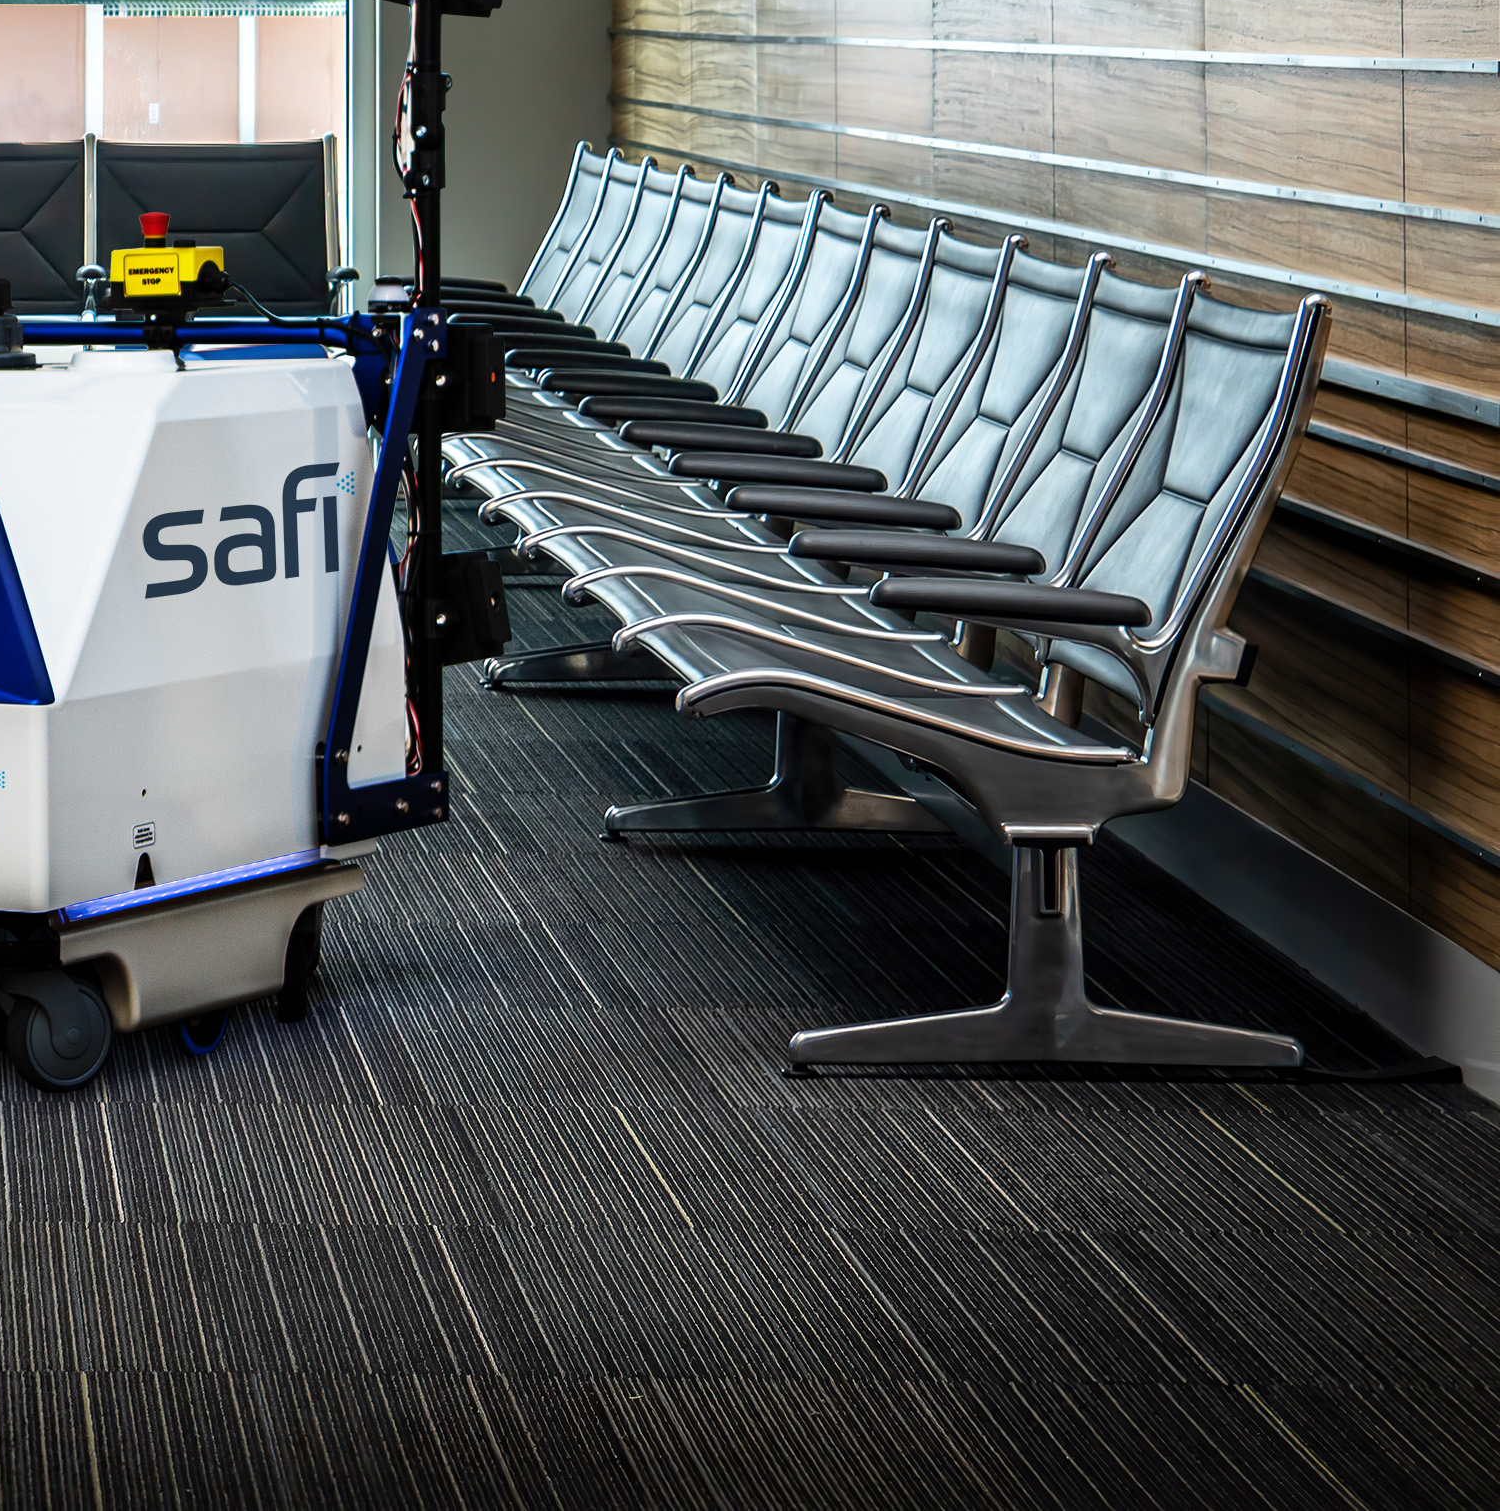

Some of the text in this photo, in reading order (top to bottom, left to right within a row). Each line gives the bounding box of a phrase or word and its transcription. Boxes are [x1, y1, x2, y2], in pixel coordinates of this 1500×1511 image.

[128, 267, 174, 276] EMERGENCY
[141, 278, 161, 286] STOP
[142, 462, 341, 599] safi
